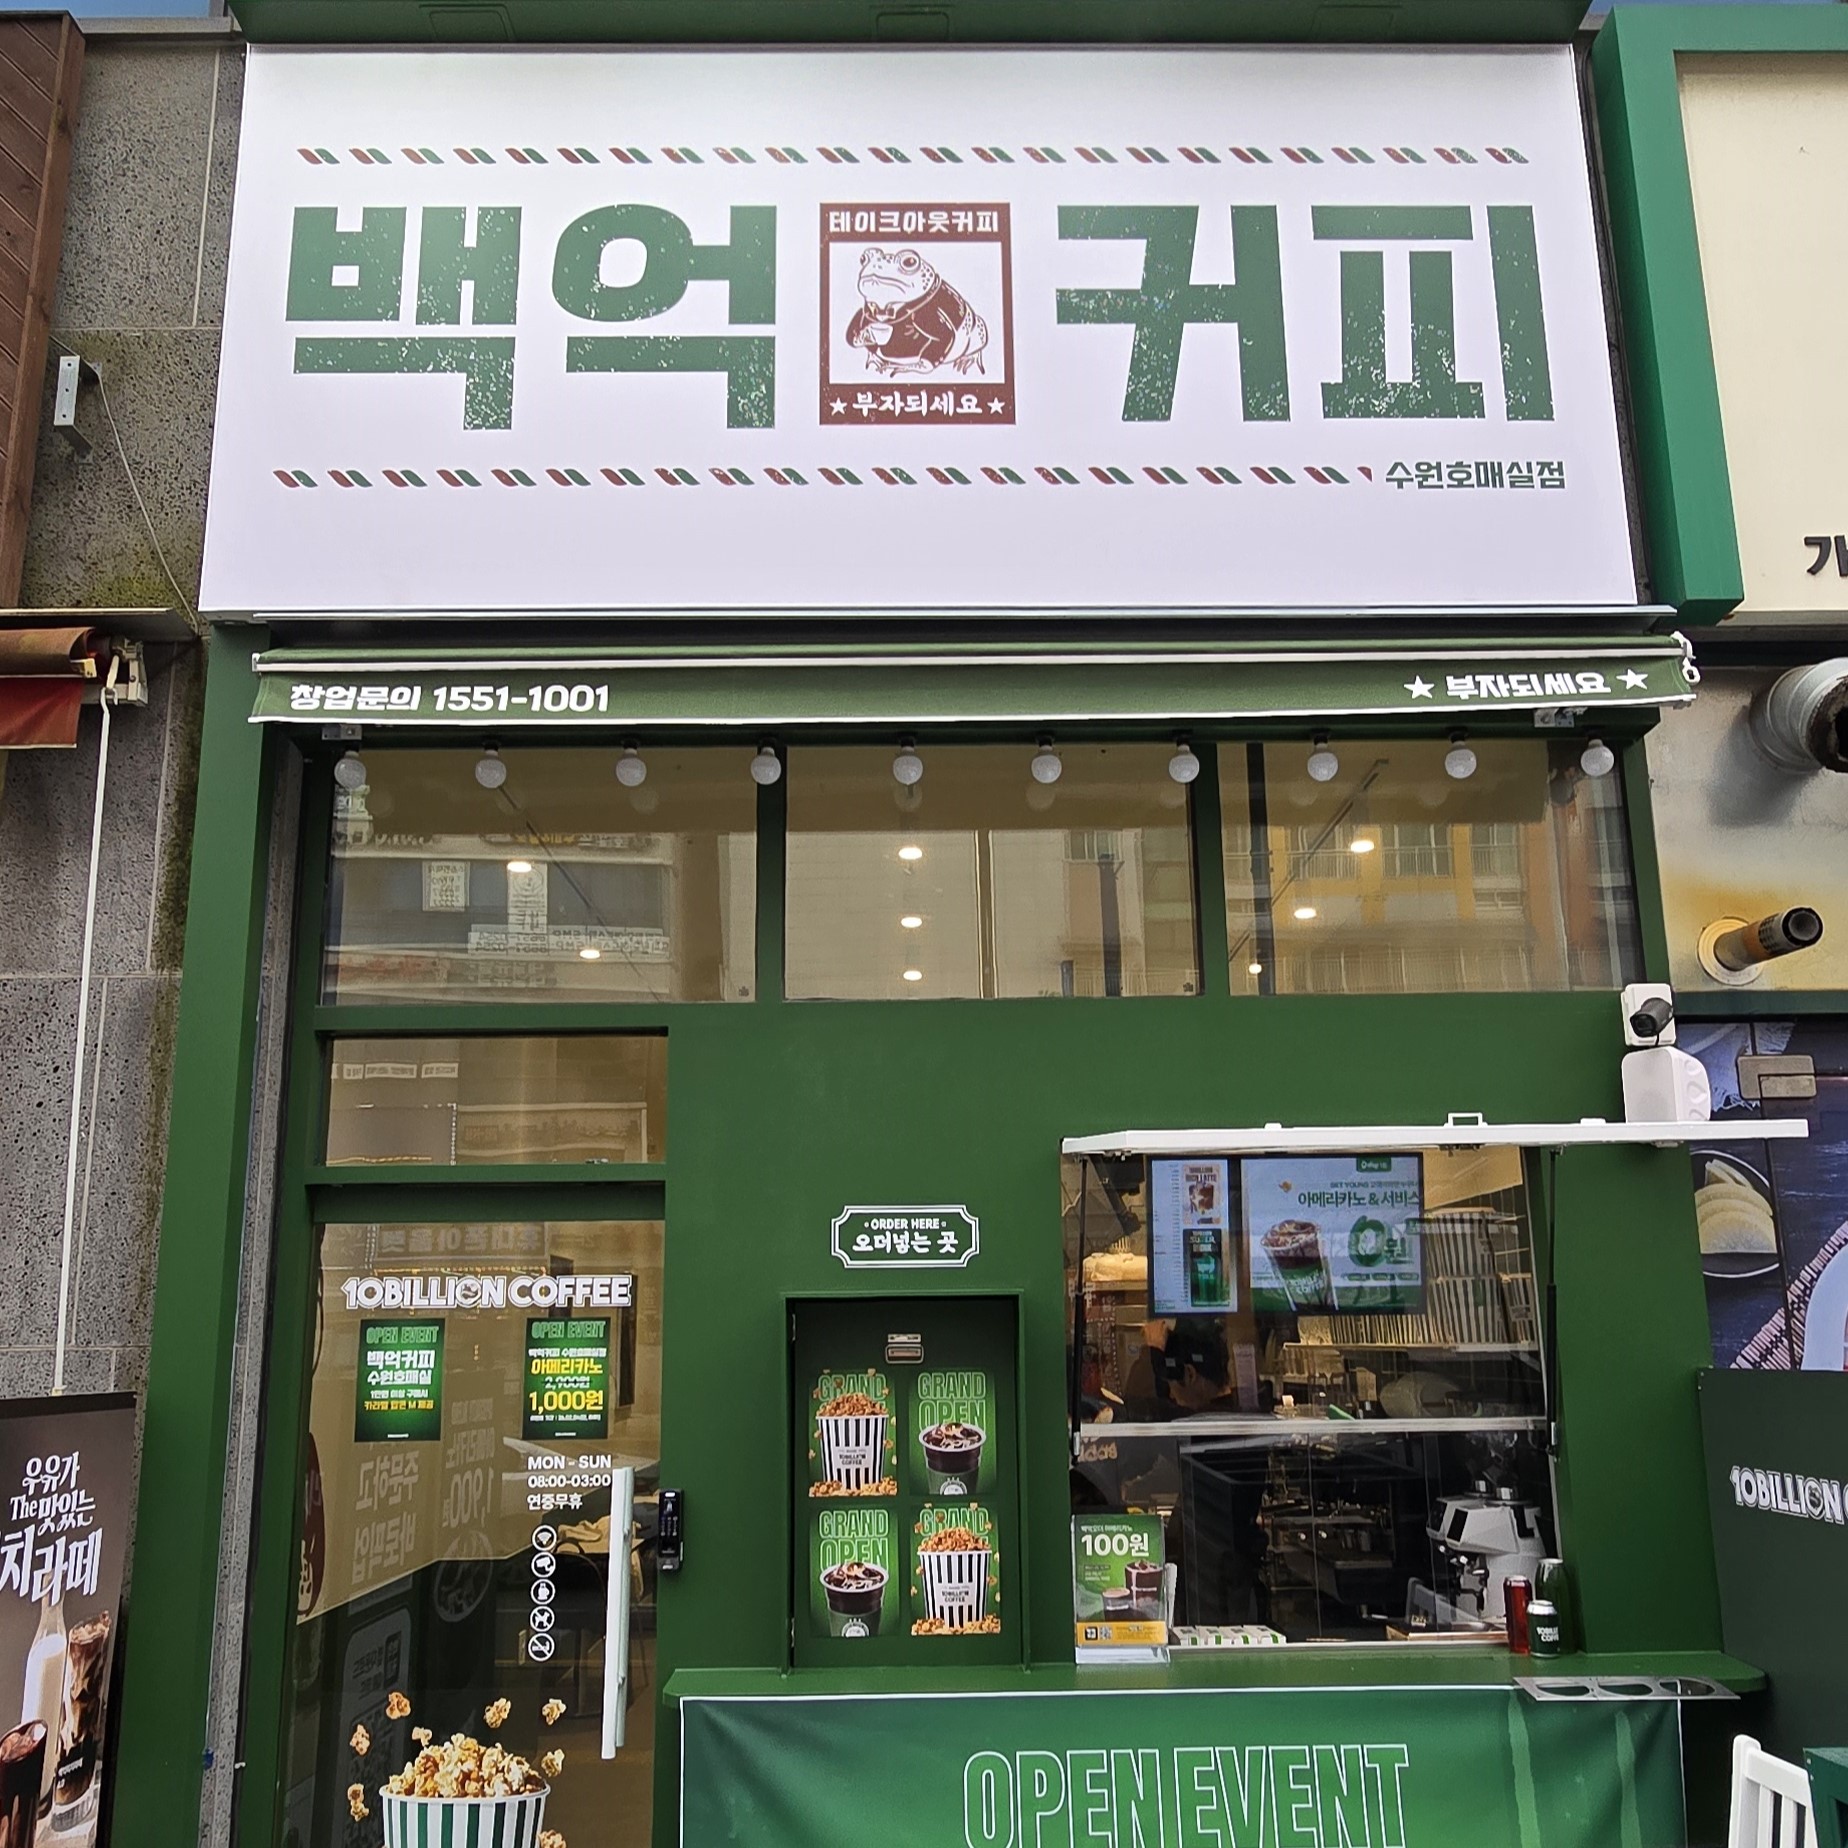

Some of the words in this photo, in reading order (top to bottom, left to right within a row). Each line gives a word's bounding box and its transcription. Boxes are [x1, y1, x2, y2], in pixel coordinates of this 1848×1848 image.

[828, 210, 999, 234] 테이크아웃커피
[286, 203, 777, 430] 백억
[1056, 204, 1555, 422] 커피
[852, 390, 984, 417] 부자되세요
[1385, 460, 1566, 490] 수원호매실점
[290, 685, 421, 711] 창업문의
[433, 684, 609, 712] 1551-1001
[1445, 672, 1612, 700] 부자되세요
[1298, 1191, 1367, 1208] 아메리카노
[1368, 1193, 1379, 1205] &
[870, 1218, 909, 1230] ORDER
[911, 1218, 940, 1229] HERE
[937, 1231, 958, 1254] 곳
[341, 1275, 506, 1309] 10BILLION
[508, 1275, 632, 1308] COFFEE
[366, 1327, 399, 1344] OPEN
[401, 1326, 439, 1343] EVENT
[531, 1321, 565, 1338] OPEN
[567, 1321, 606, 1338] EVENT
[367, 1350, 436, 1369] 백억커피
[531, 1358, 603, 1374] 아메리카노
[917, 1371, 987, 1399] GRAND
[529, 1390, 604, 1414] 1,000원
[918, 1400, 987, 1430] OPEN
[22, 1451, 80, 1496] 우유가
[527, 1456, 566, 1470] MON
[578, 1454, 612, 1468] SUN
[527, 1474, 611, 1488] 08:00-03:00
[526, 1493, 583, 1511] 연중무휴
[1730, 1466, 1845, 1525] 10BILLION
[819, 1509, 889, 1538] GRAND
[820, 1537, 889, 1572] OPEN
[1081, 1533, 1149, 1557] 100원
[0, 1524, 103, 1606] 치라떼
[963, 1748, 1166, 1848] OPEN
[1173, 1744, 1410, 1848] EVENT
